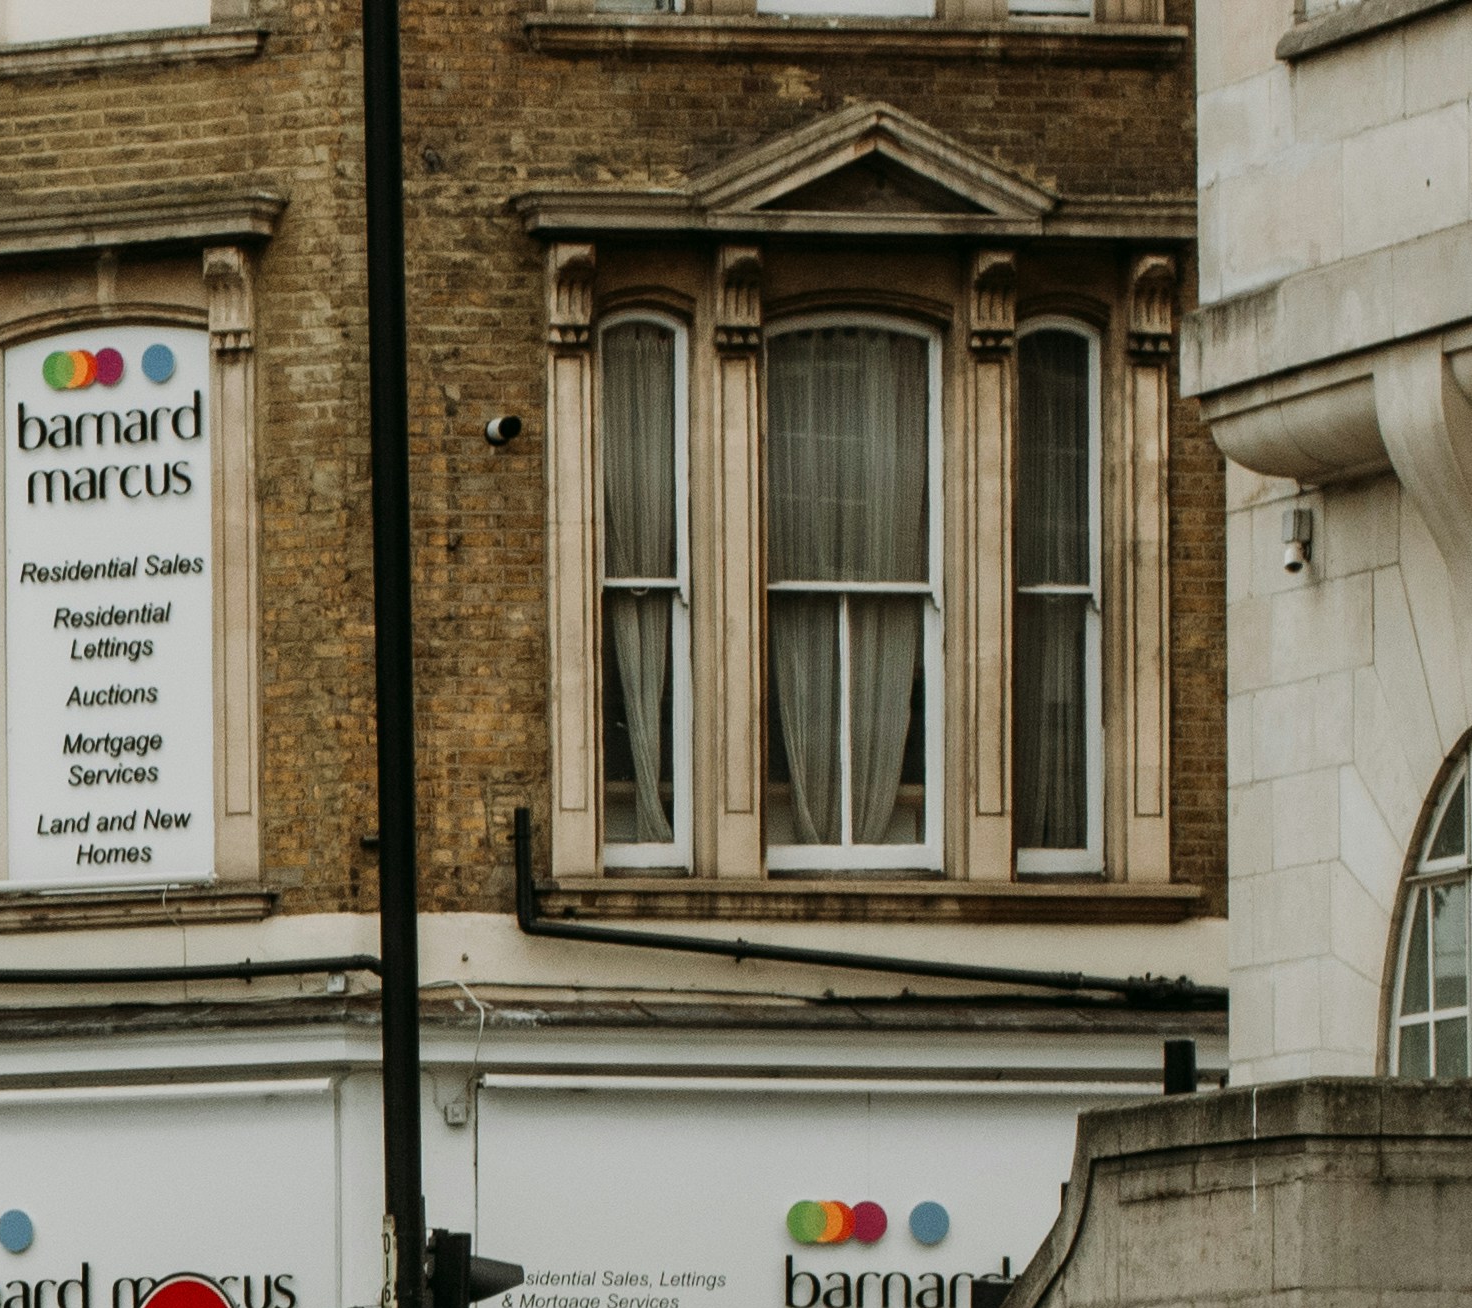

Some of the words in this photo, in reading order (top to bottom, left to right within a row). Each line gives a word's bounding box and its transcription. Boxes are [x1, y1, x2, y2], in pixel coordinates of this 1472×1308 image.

[18, 389, 202, 451] barnard
[26, 460, 192, 505] marcus
[20, 557, 137, 584] Residential
[144, 554, 204, 577] Sales
[53, 603, 171, 629] Residential
[70, 635, 154, 663] Lettings
[66, 684, 158, 708] Auctions
[63, 731, 163, 759] Mortgage
[68, 762, 158, 787] Services
[37, 812, 89, 837] Land
[96, 812, 134, 833] and
[143, 808, 190, 829] New
[76, 842, 152, 866] Homes
[524, 1269, 596, 1288] sidential
[601, 1269, 654, 1291] Sales,
[660, 1269, 727, 1291] Lettings
